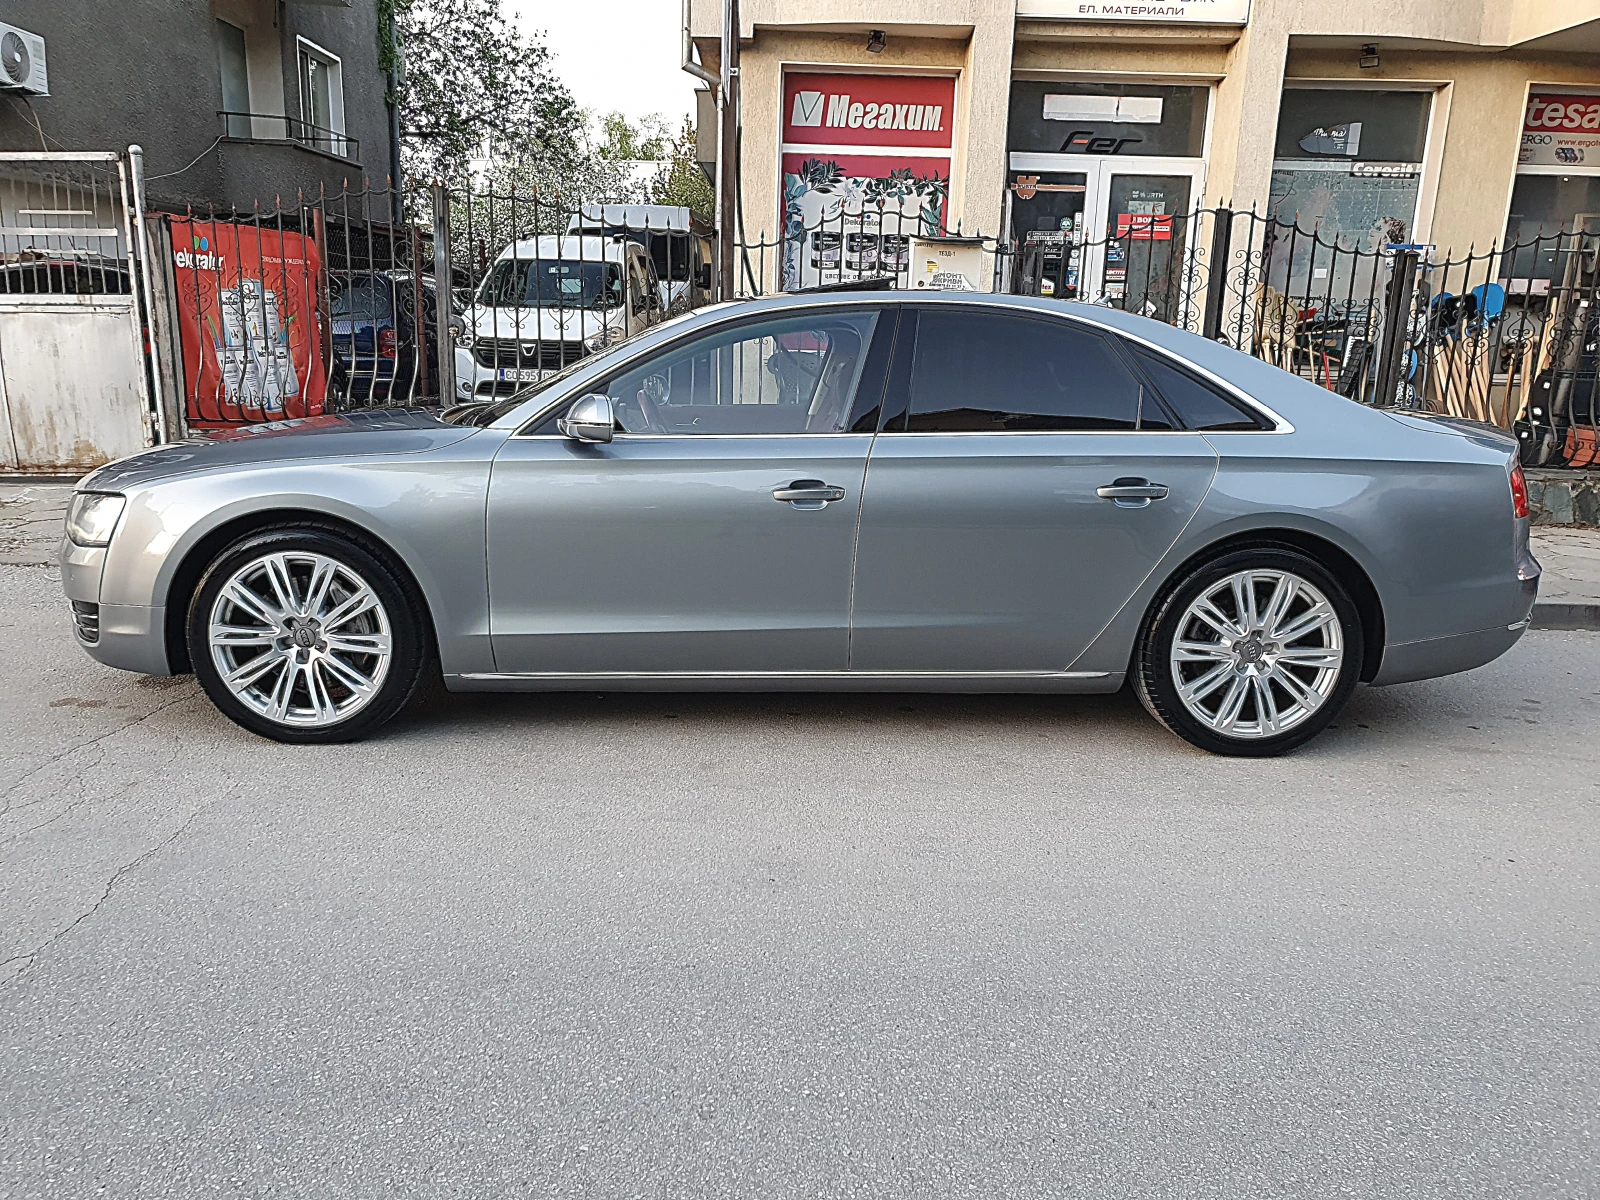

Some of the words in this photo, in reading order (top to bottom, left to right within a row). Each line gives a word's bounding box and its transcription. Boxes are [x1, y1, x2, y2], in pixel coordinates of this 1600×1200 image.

[1078, 4, 1098, 14] ЕЛ.
[1102, 5, 1185, 16] МАТЕРИАЛИ
[1526, 98, 1600, 129] tesa
[1060, 130, 1143, 154] Fer
[1557, 139, 1600, 148] www.ergot
[1352, 162, 1414, 178] Ceresit
